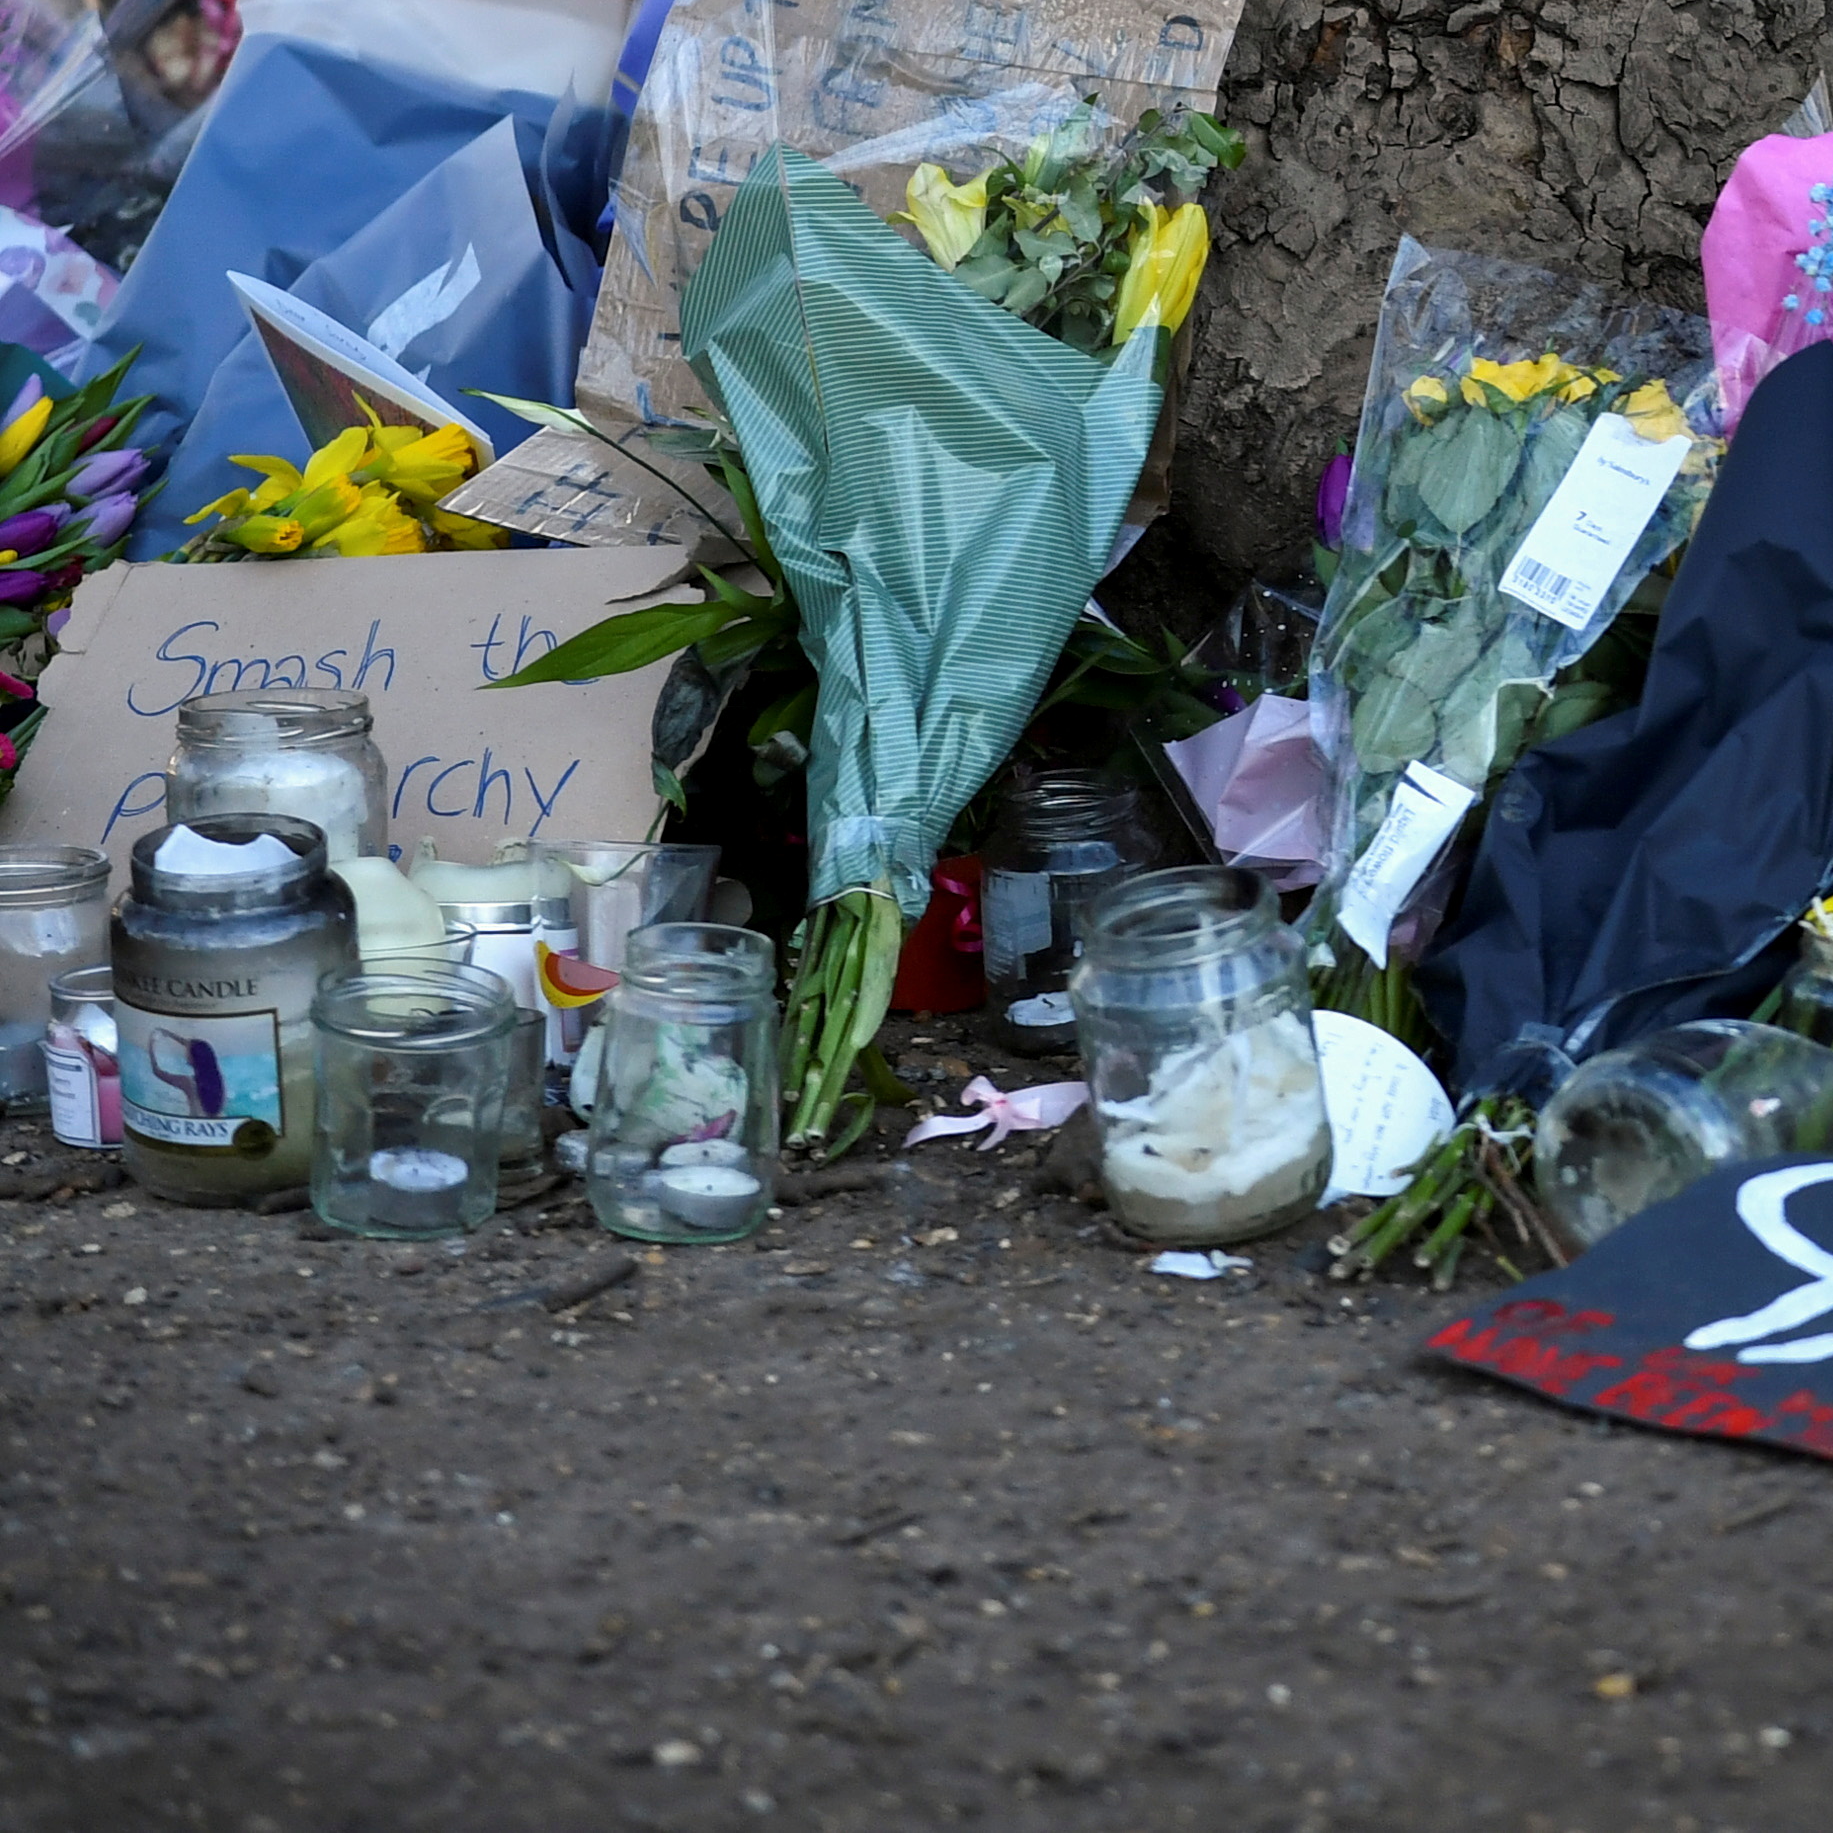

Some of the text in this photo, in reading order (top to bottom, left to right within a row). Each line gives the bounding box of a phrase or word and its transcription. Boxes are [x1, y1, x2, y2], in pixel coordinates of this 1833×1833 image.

[128, 612, 603, 717] Smash th
[166, 978, 258, 1000] CANDLE
[184, 1120, 229, 1139] RAYS
